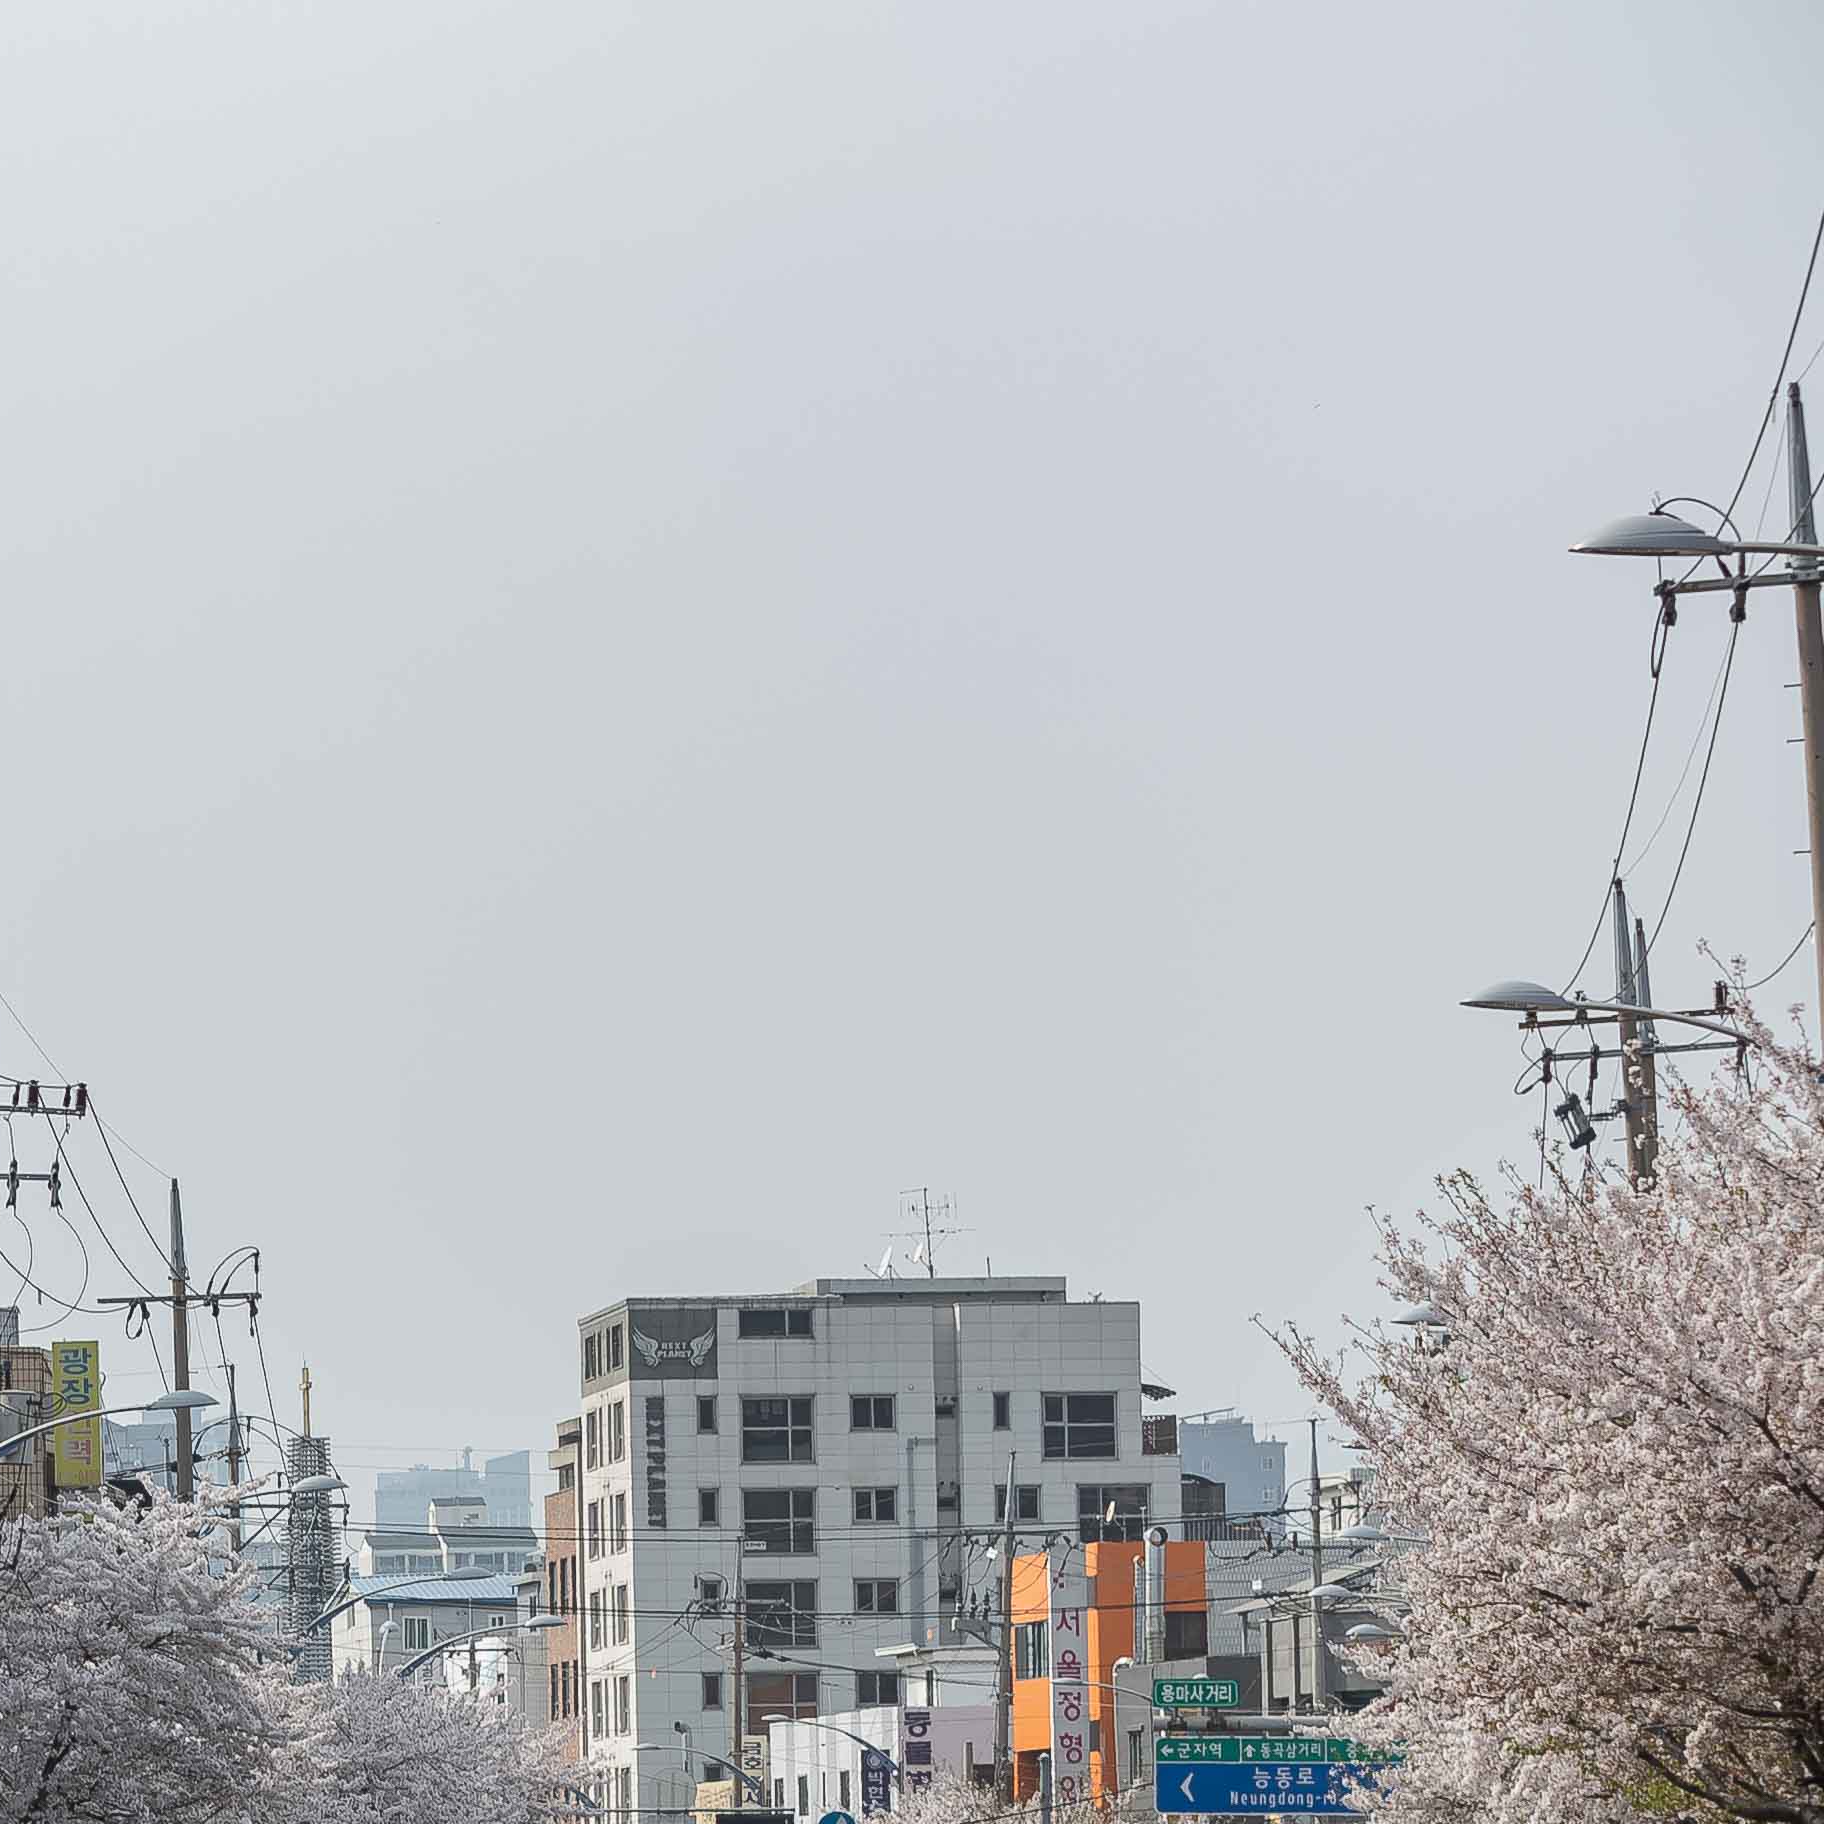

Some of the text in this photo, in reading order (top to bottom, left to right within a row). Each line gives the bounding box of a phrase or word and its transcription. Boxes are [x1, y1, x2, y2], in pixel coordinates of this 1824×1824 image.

[1160, 1684, 1233, 1703] 용마사거리
[1177, 1743, 1223, 1758] 군자역
[1253, 1766, 1316, 1790] 능동로
